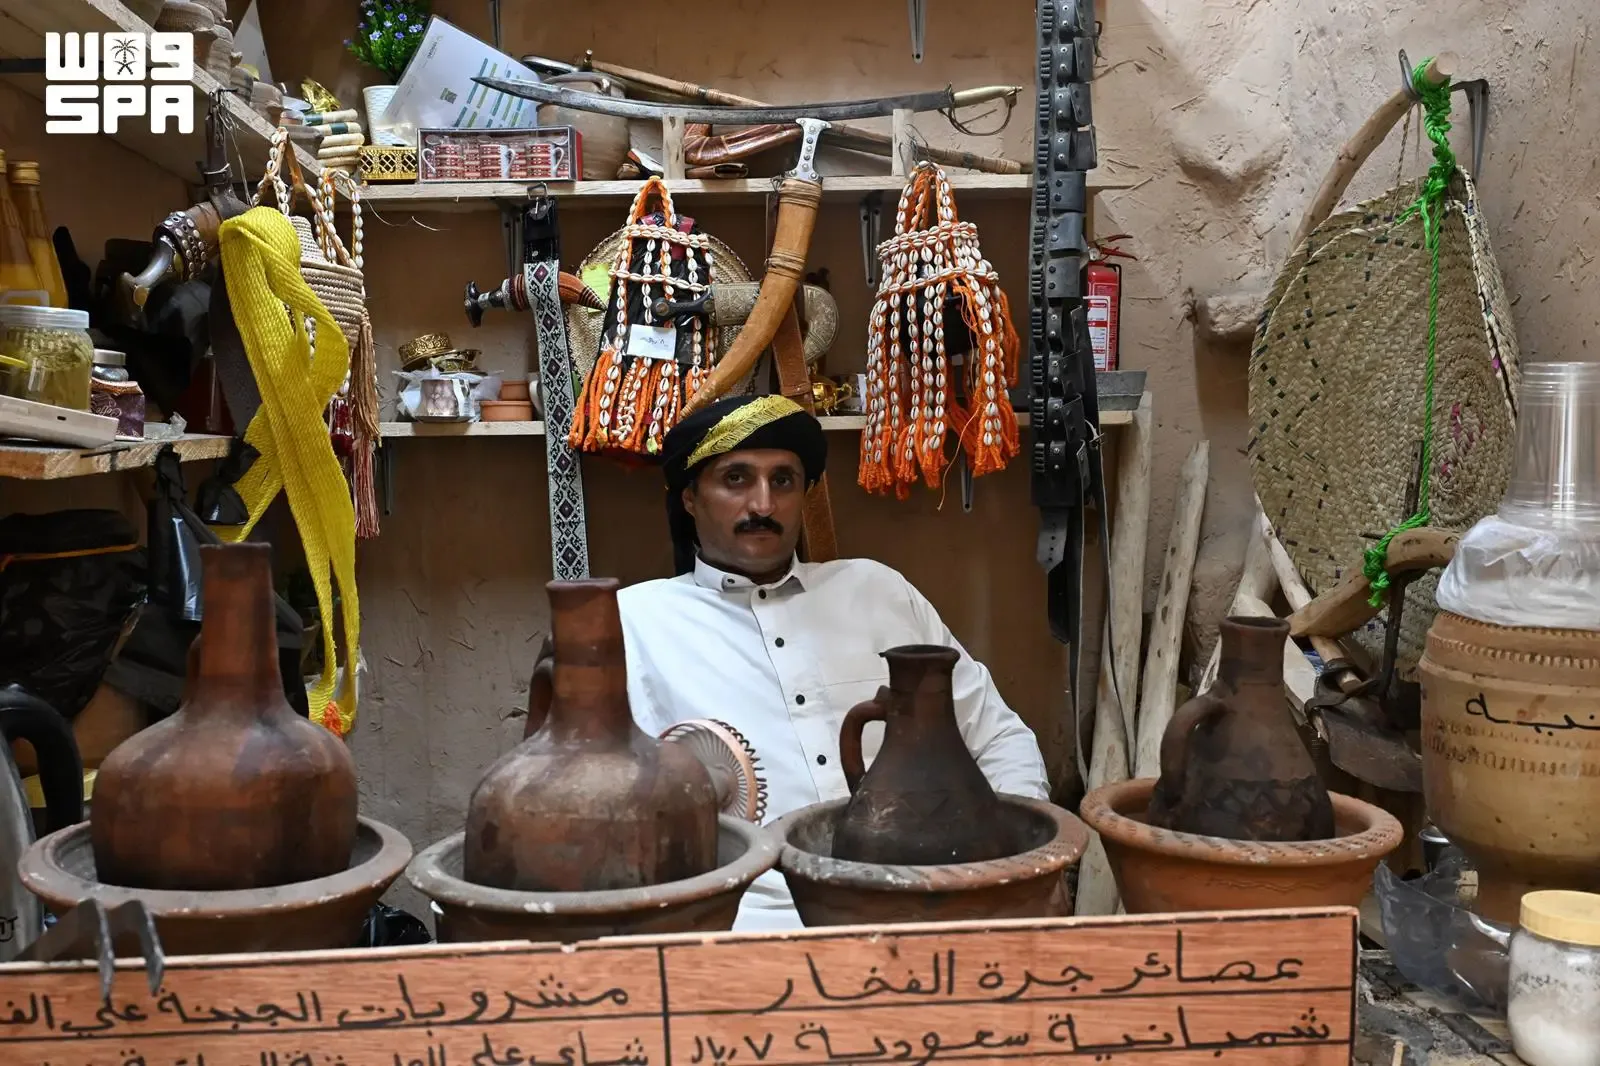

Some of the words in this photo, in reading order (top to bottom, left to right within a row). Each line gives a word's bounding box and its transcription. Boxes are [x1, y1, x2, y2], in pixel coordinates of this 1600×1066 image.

[752, 949, 955, 1015] الفخار
[978, 961, 1094, 1002] جرة
[1100, 929, 1302, 993] عصائر
[0, 991, 55, 1031] الف
[337, 973, 629, 1037] مشروبات
[743, 1033, 773, 1060] ٧
[794, 1022, 1029, 1066] سعودية
[1047, 1003, 1330, 1061] شمبانية
